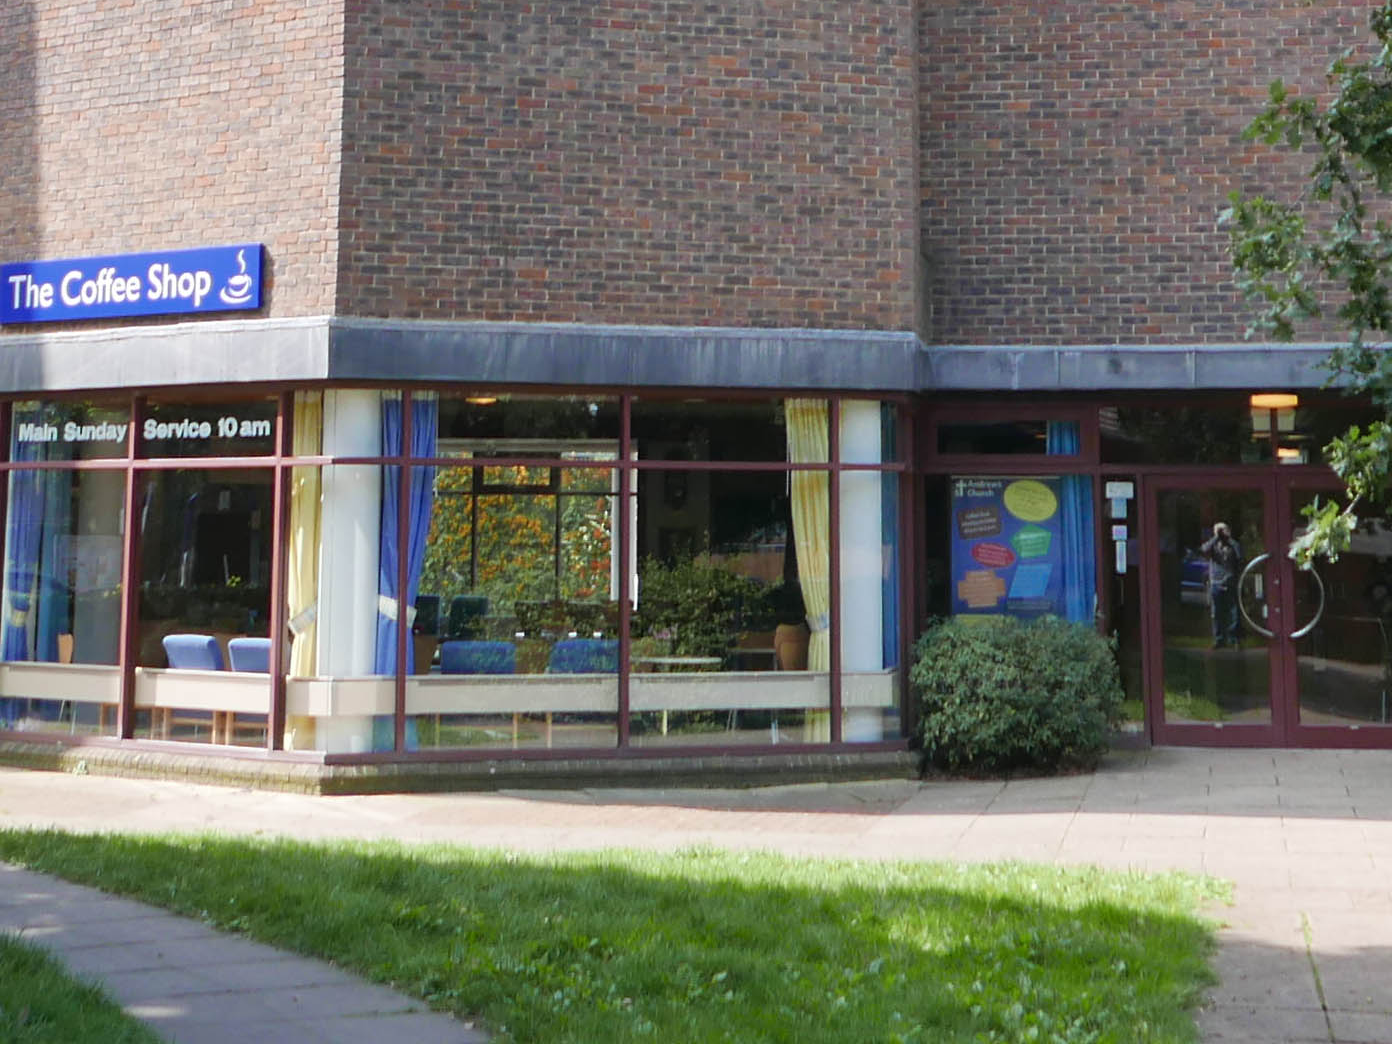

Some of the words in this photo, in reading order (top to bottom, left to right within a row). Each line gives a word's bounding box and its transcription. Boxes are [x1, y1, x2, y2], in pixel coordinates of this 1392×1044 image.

[9, 274, 54, 309] The
[61, 267, 141, 305] Coffee
[148, 264, 212, 306] Shop
[18, 422, 58, 442] Main
[63, 421, 128, 443] Sunday
[143, 418, 211, 440] Service
[217, 416, 238, 438] 10
[239, 419, 271, 437] am
